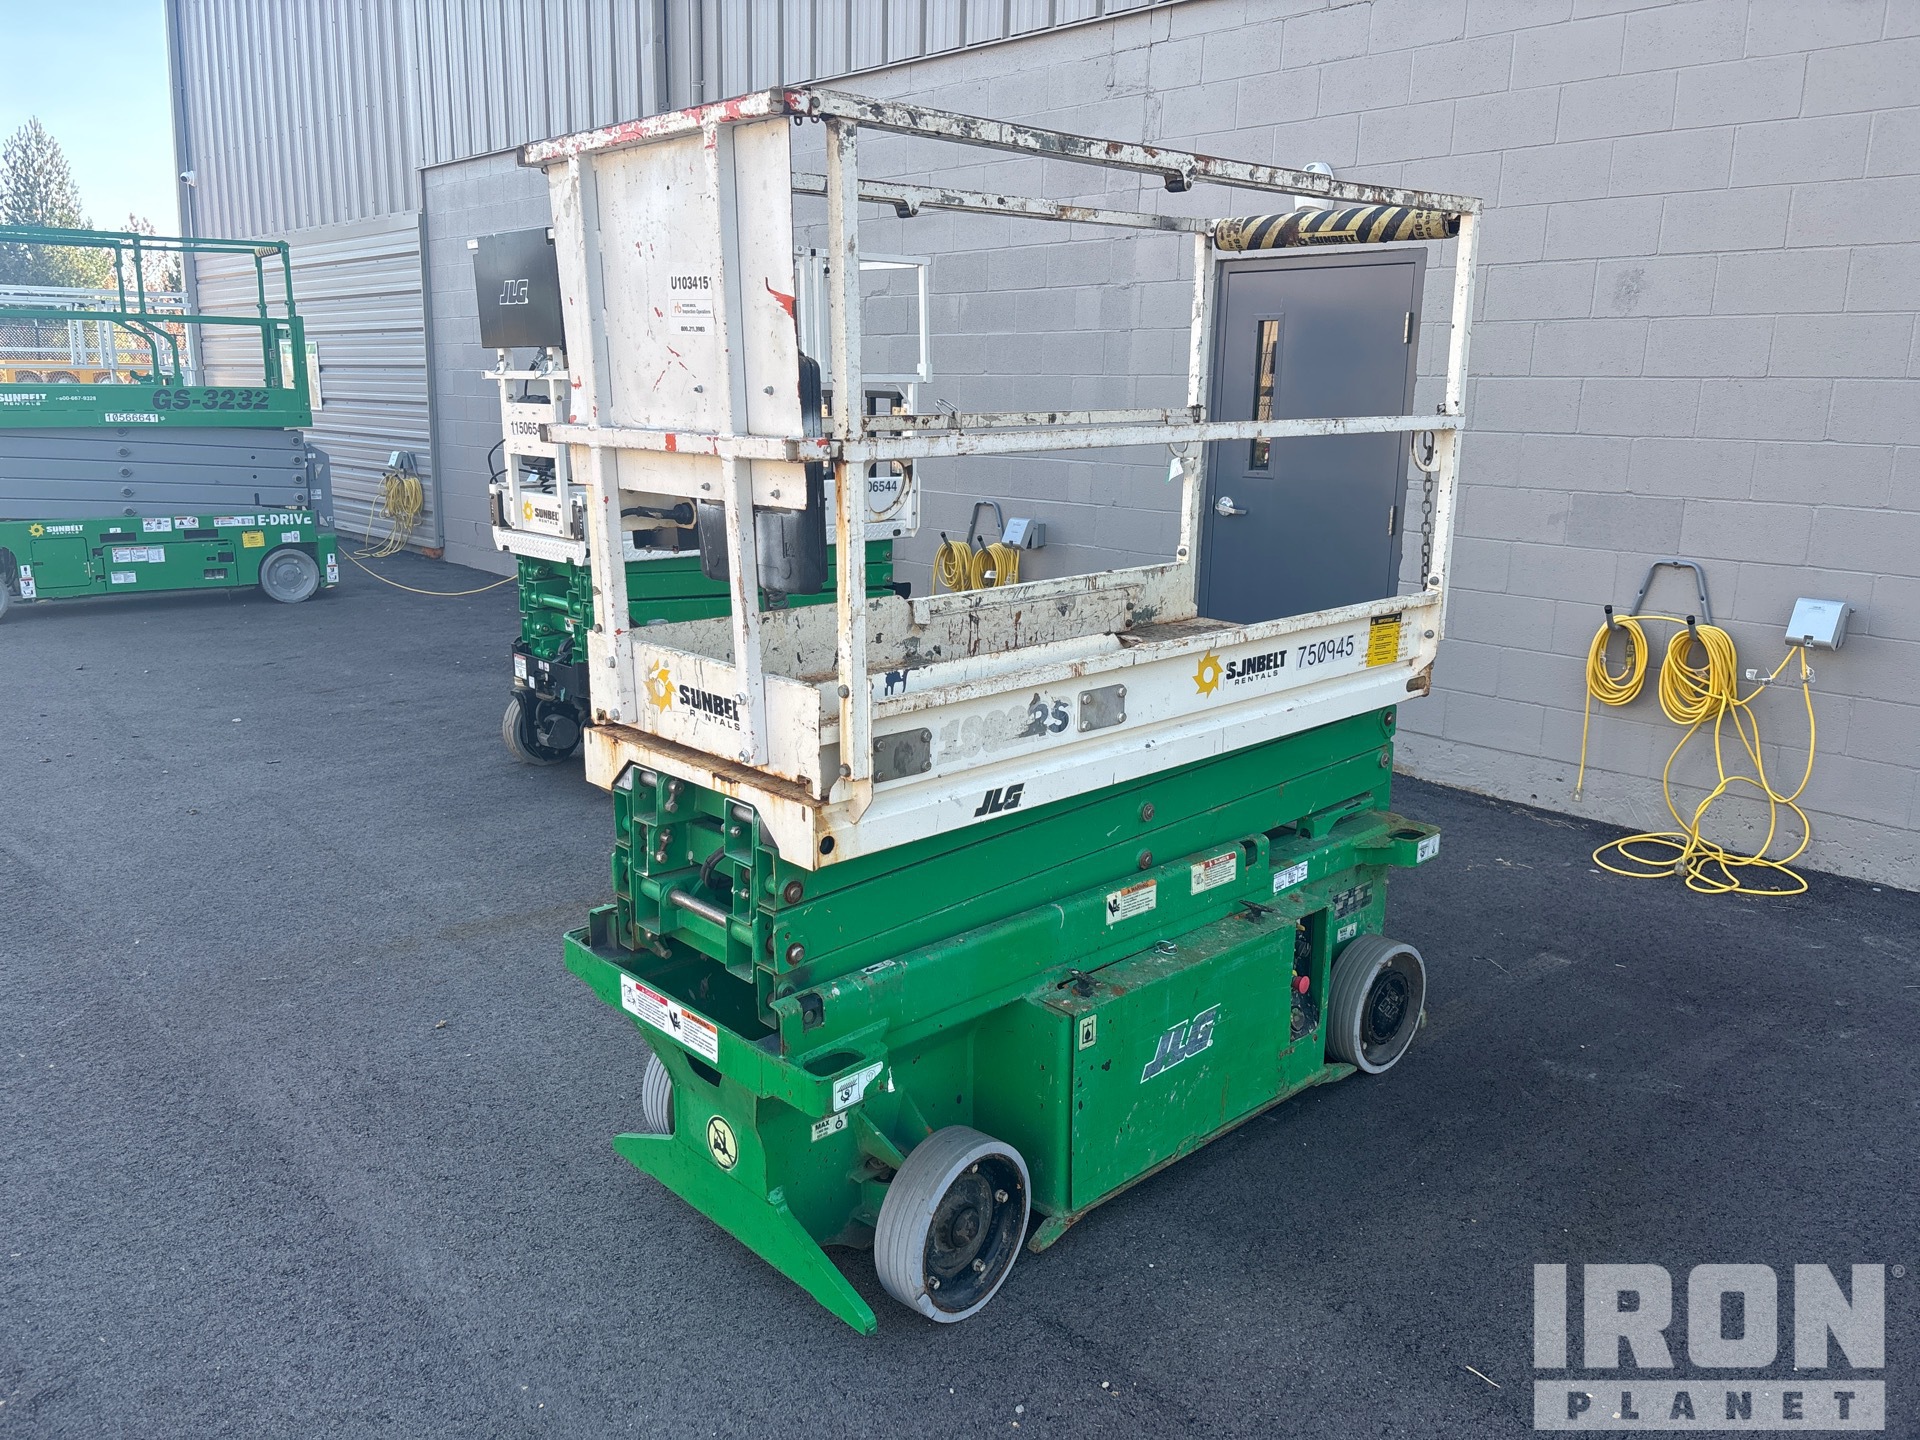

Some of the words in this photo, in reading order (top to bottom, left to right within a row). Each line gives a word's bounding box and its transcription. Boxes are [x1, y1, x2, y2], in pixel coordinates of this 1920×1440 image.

[499, 279, 529, 305] JLG
[152, 389, 269, 410] GS-3232
[105, 413, 157, 422] 10566641
[46, 524, 84, 533] SUNBELT
[1297, 634, 1355, 669] 750945
[1234, 669, 1279, 686] RENTALS
[689, 708, 741, 732] RNTALS
[974, 783, 1025, 818] JLG
[1140, 1002, 1222, 1084] JLG
[815, 1119, 830, 1131] MAX
